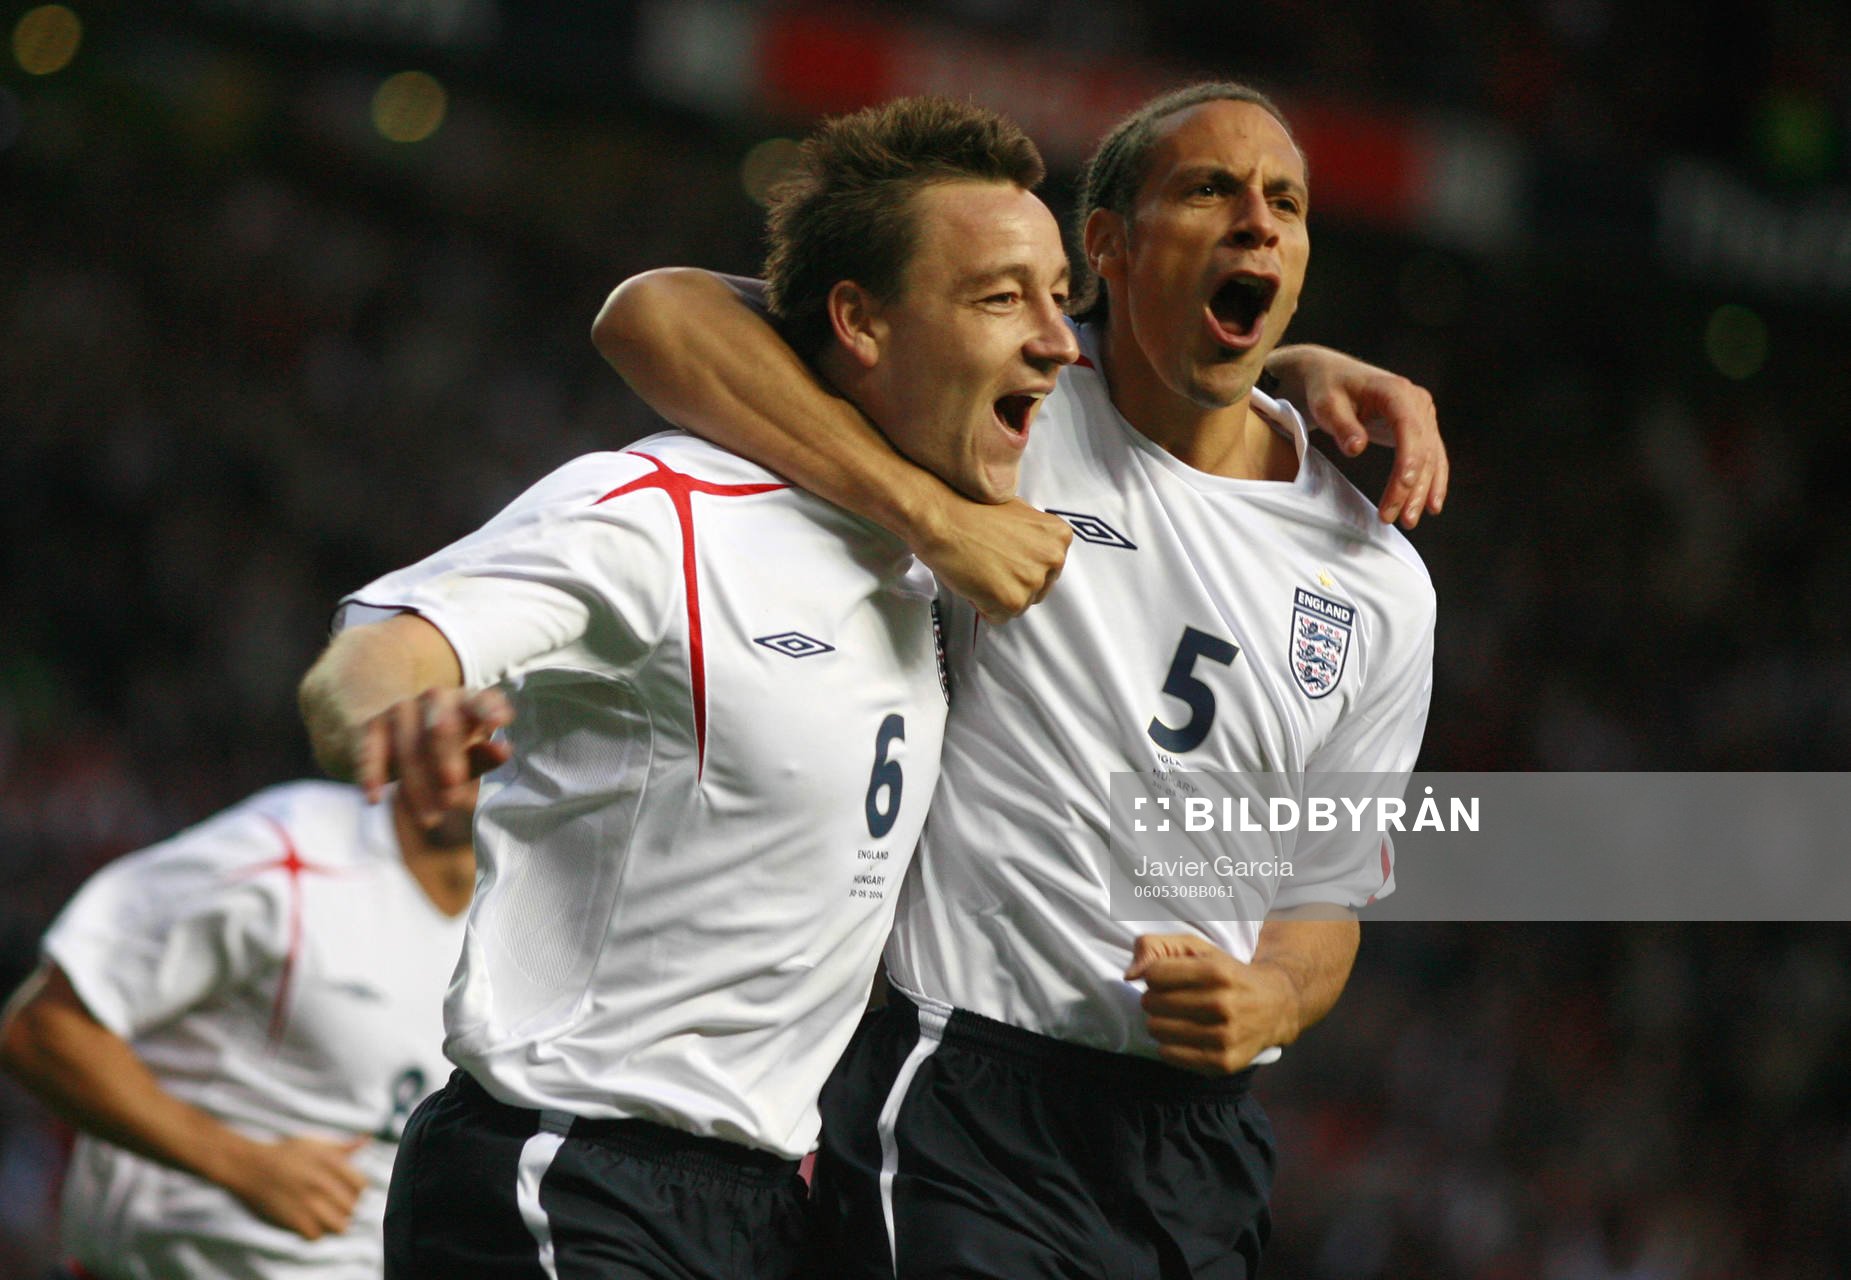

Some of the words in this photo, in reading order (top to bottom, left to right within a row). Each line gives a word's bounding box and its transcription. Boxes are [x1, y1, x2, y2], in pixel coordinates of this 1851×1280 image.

[1298, 590, 1350, 620] ENGLAND
[1147, 625, 1240, 753] 5
[865, 713, 905, 838] 6
[857, 849, 889, 860] ENGLAND
[854, 874, 886, 886] HUNGARY
